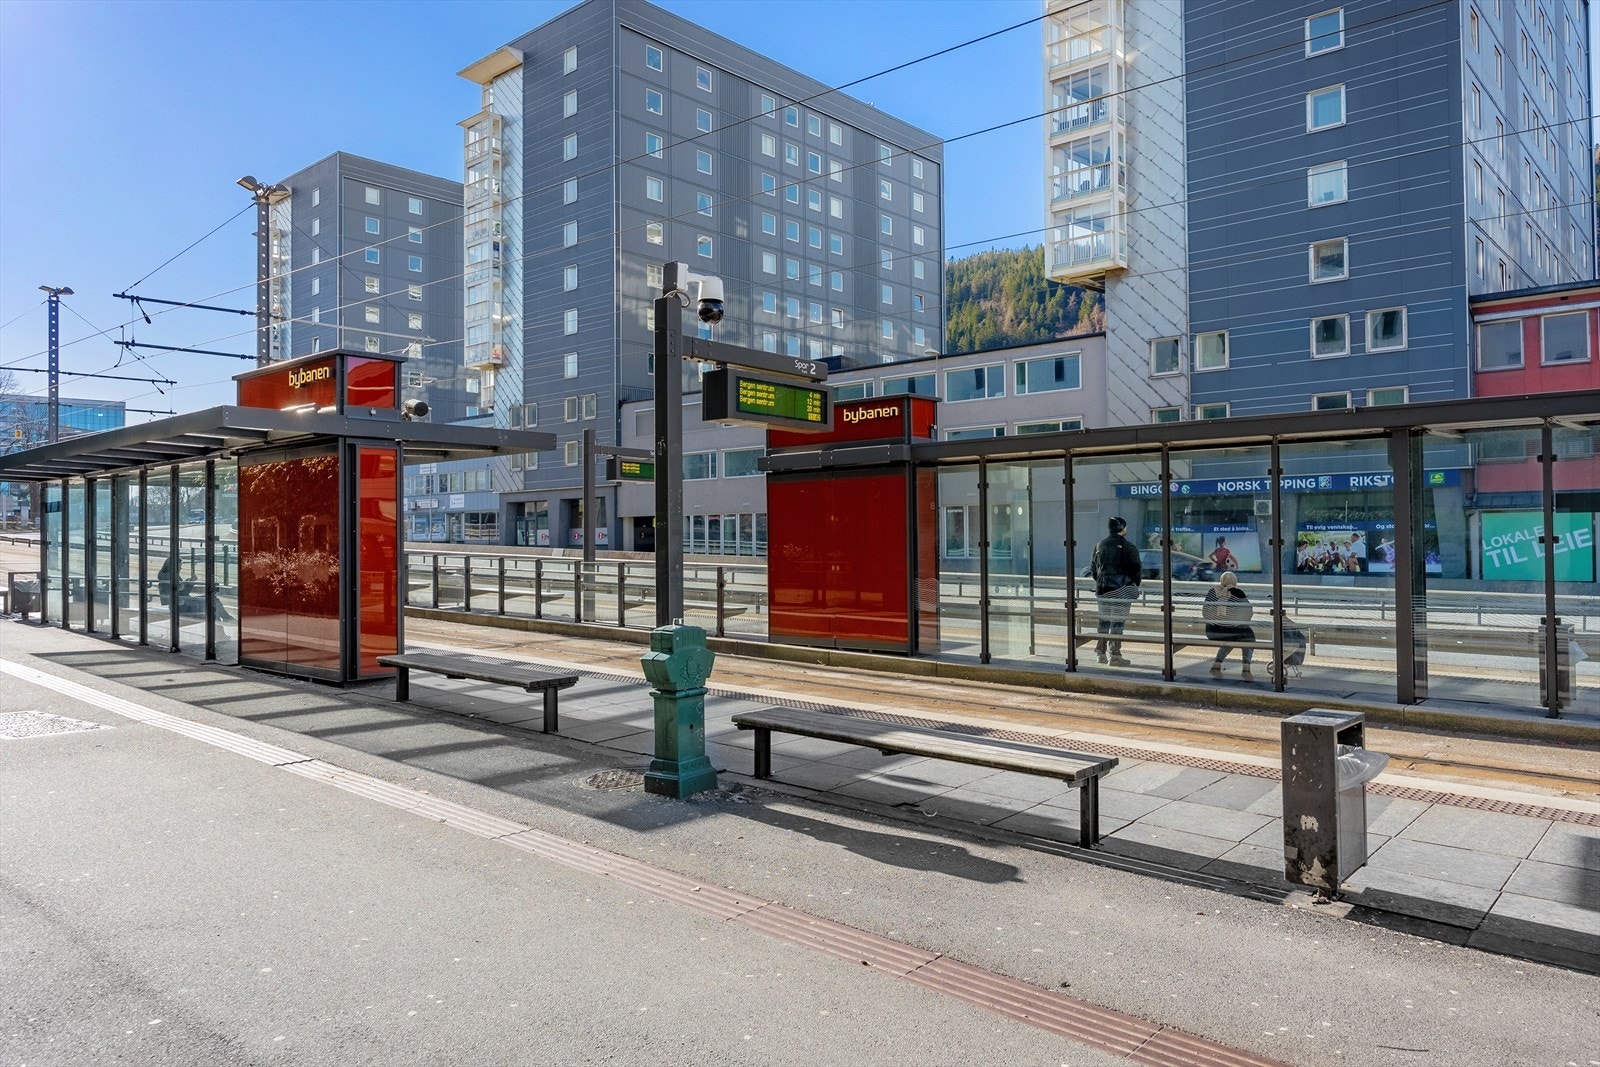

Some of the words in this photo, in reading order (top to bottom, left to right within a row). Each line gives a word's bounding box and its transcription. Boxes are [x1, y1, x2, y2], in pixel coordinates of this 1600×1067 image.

[794, 359, 809, 370] Spor
[810, 363, 816, 375] 2
[288, 366, 329, 389] bybanen
[739, 380, 755, 389] Bergen
[756, 384, 774, 392] sentrum
[739, 387, 755, 397] Bergen
[756, 391, 774, 399] sentrum
[739, 395, 755, 404] Bergen
[756, 399, 774, 407] sentrum
[843, 406, 898, 423] bybanen
[1217, 480, 1260, 491] NORSK
[1264, 478, 1316, 490] TPING
[1350, 475, 1394, 486] RIKST
[1485, 546, 1528, 568] TIL
[1531, 527, 1593, 558] LEIE
